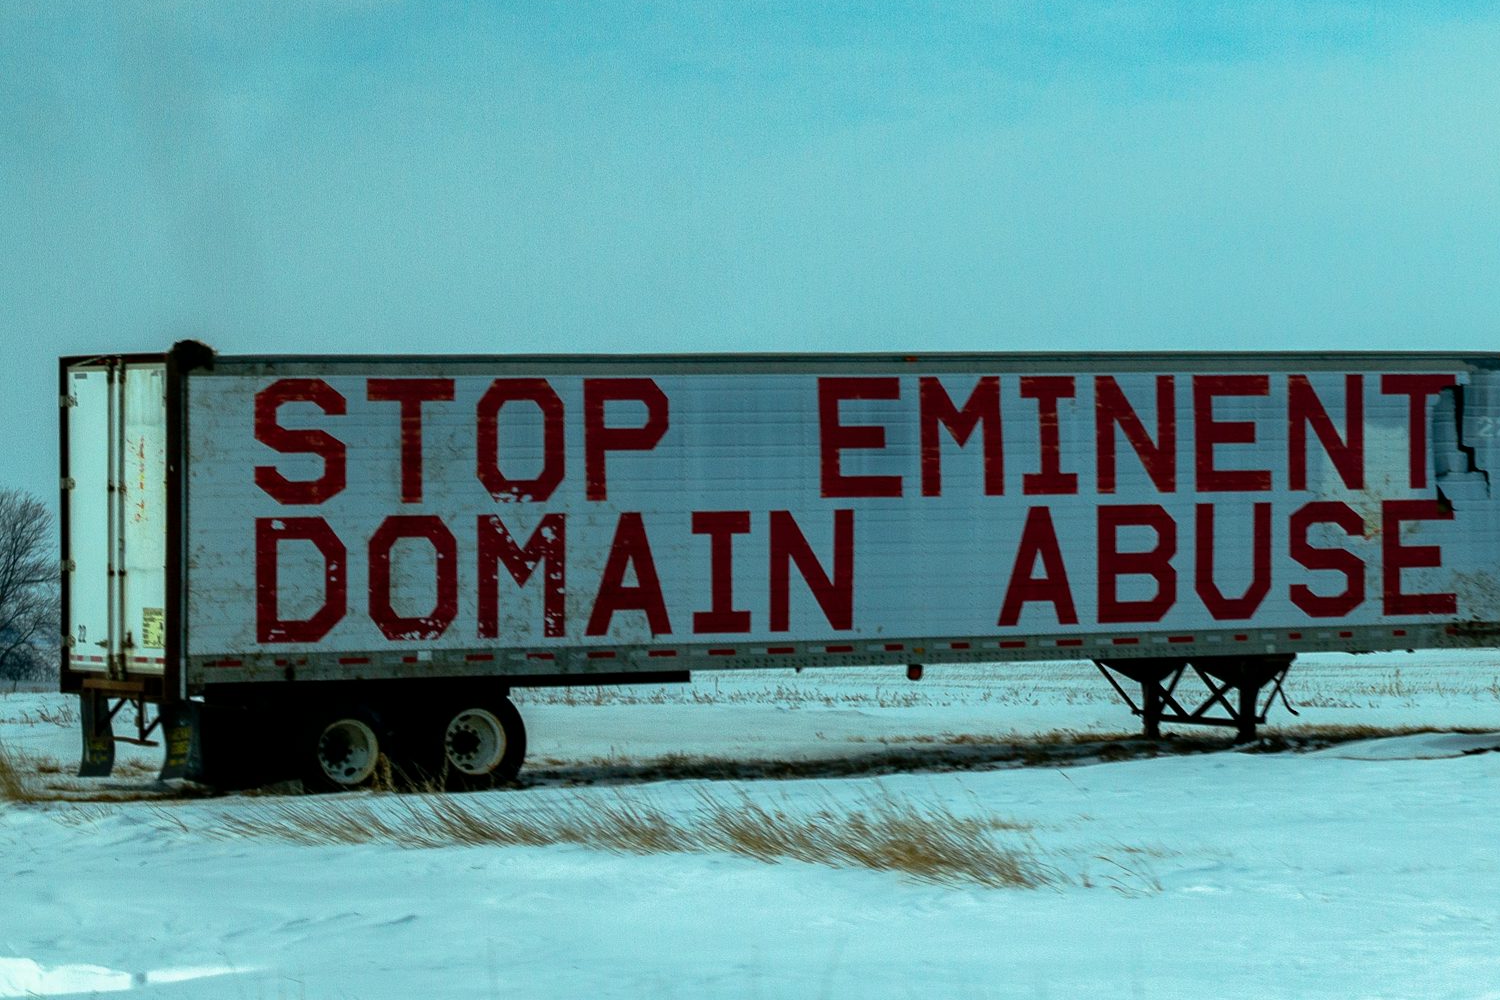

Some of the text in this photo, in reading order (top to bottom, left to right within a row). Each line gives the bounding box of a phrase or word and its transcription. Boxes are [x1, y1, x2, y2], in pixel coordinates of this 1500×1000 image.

[254, 378, 670, 505] STOP
[817, 374, 1457, 498] EMINENT
[255, 499, 1458, 644] DOMAIN ABUSE
